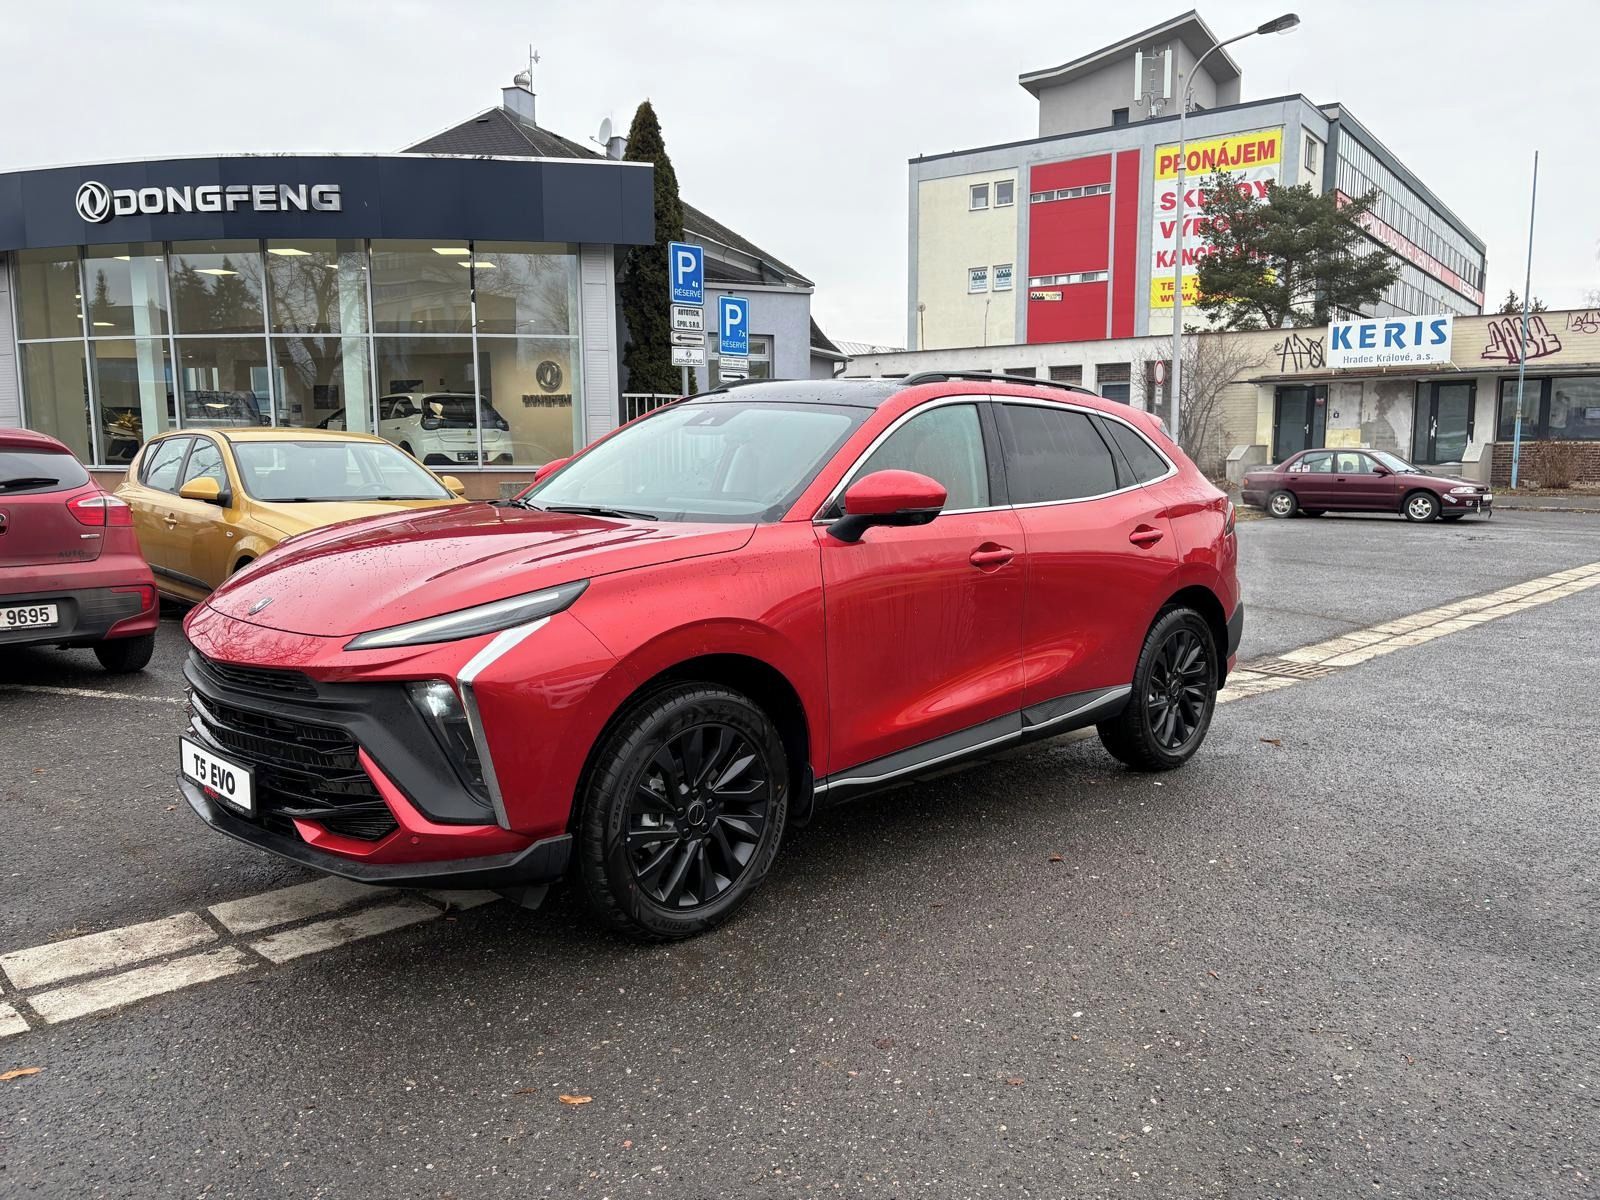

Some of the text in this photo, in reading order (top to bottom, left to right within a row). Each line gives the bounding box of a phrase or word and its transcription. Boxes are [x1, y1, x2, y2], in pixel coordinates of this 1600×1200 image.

[113, 184, 341, 216] DONGFENG
[678, 251, 697, 285] P
[674, 287, 702, 298] RÉSERVÉ
[1160, 282, 1188, 291] TE.:
[725, 303, 743, 337] P
[1331, 319, 1448, 350] KERIS
[1343, 352, 1434, 364] Hradec Králové, a.s.
[6, 606, 50, 625] 9695
[193, 753, 207, 780] T5
[211, 763, 236, 795] EVO
